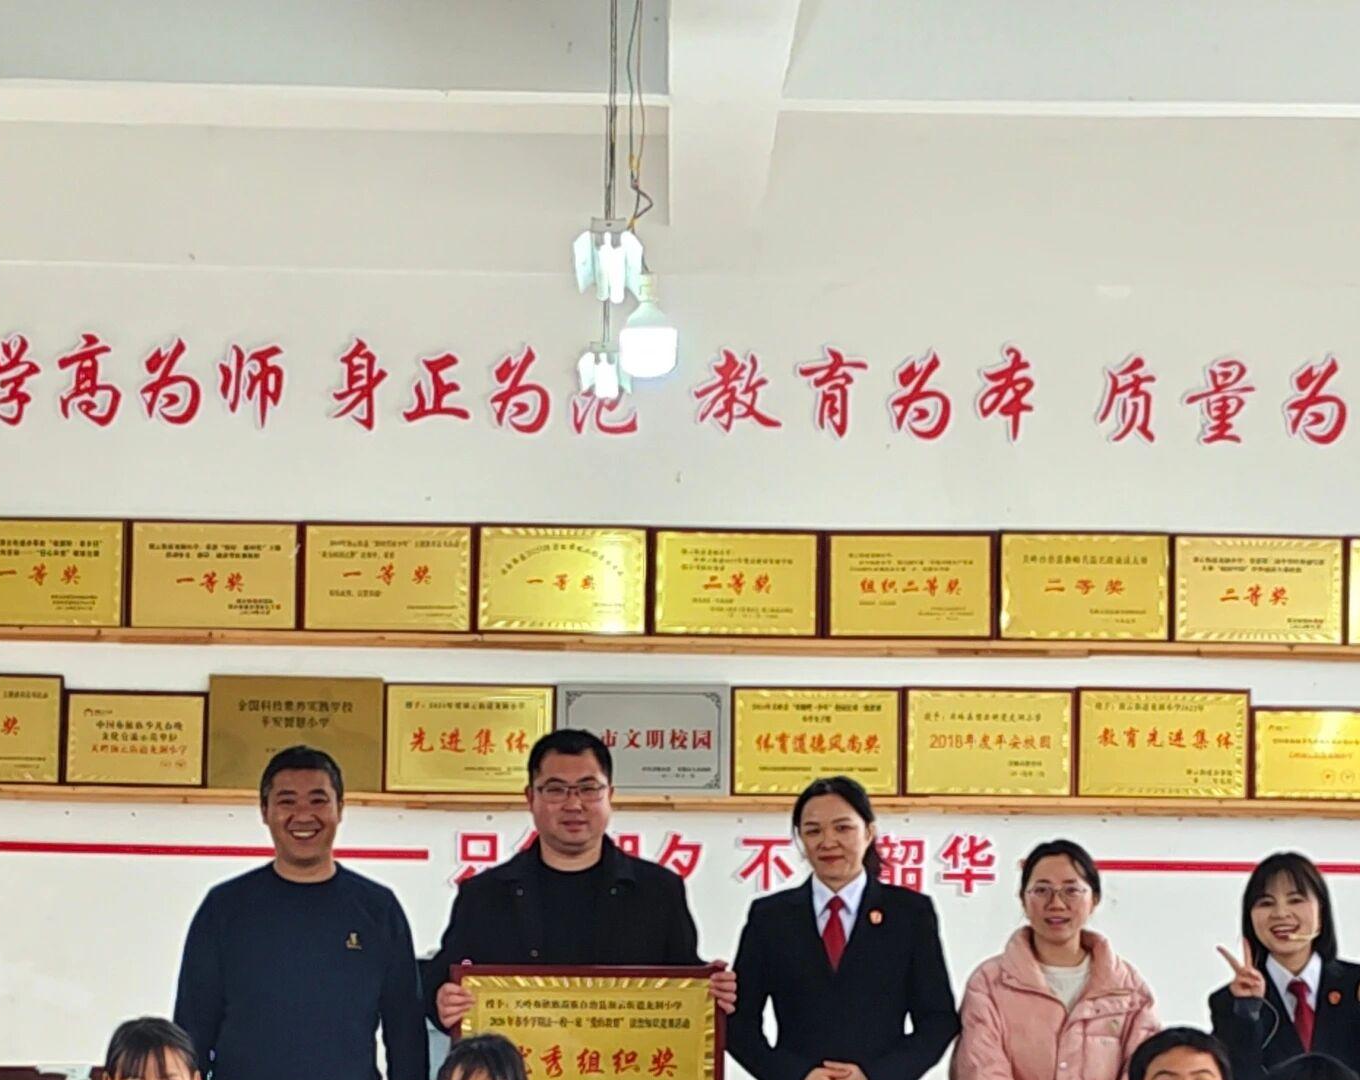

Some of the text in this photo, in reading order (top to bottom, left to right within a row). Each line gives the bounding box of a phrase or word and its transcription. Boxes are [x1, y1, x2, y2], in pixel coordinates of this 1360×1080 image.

[695, 347, 1036, 443] 教育为本
[175, 570, 244, 593] 一等奖
[342, 562, 432, 586] 一等奖
[702, 571, 772, 595] 二等奖
[1044, 578, 1126, 595] 二等奖
[1219, 583, 1289, 607] 二等奖
[409, 725, 530, 755] 先进集体
[1097, 726, 1235, 750] 教育先进集体
[455, 832, 997, 893] 只夕 不韶华
